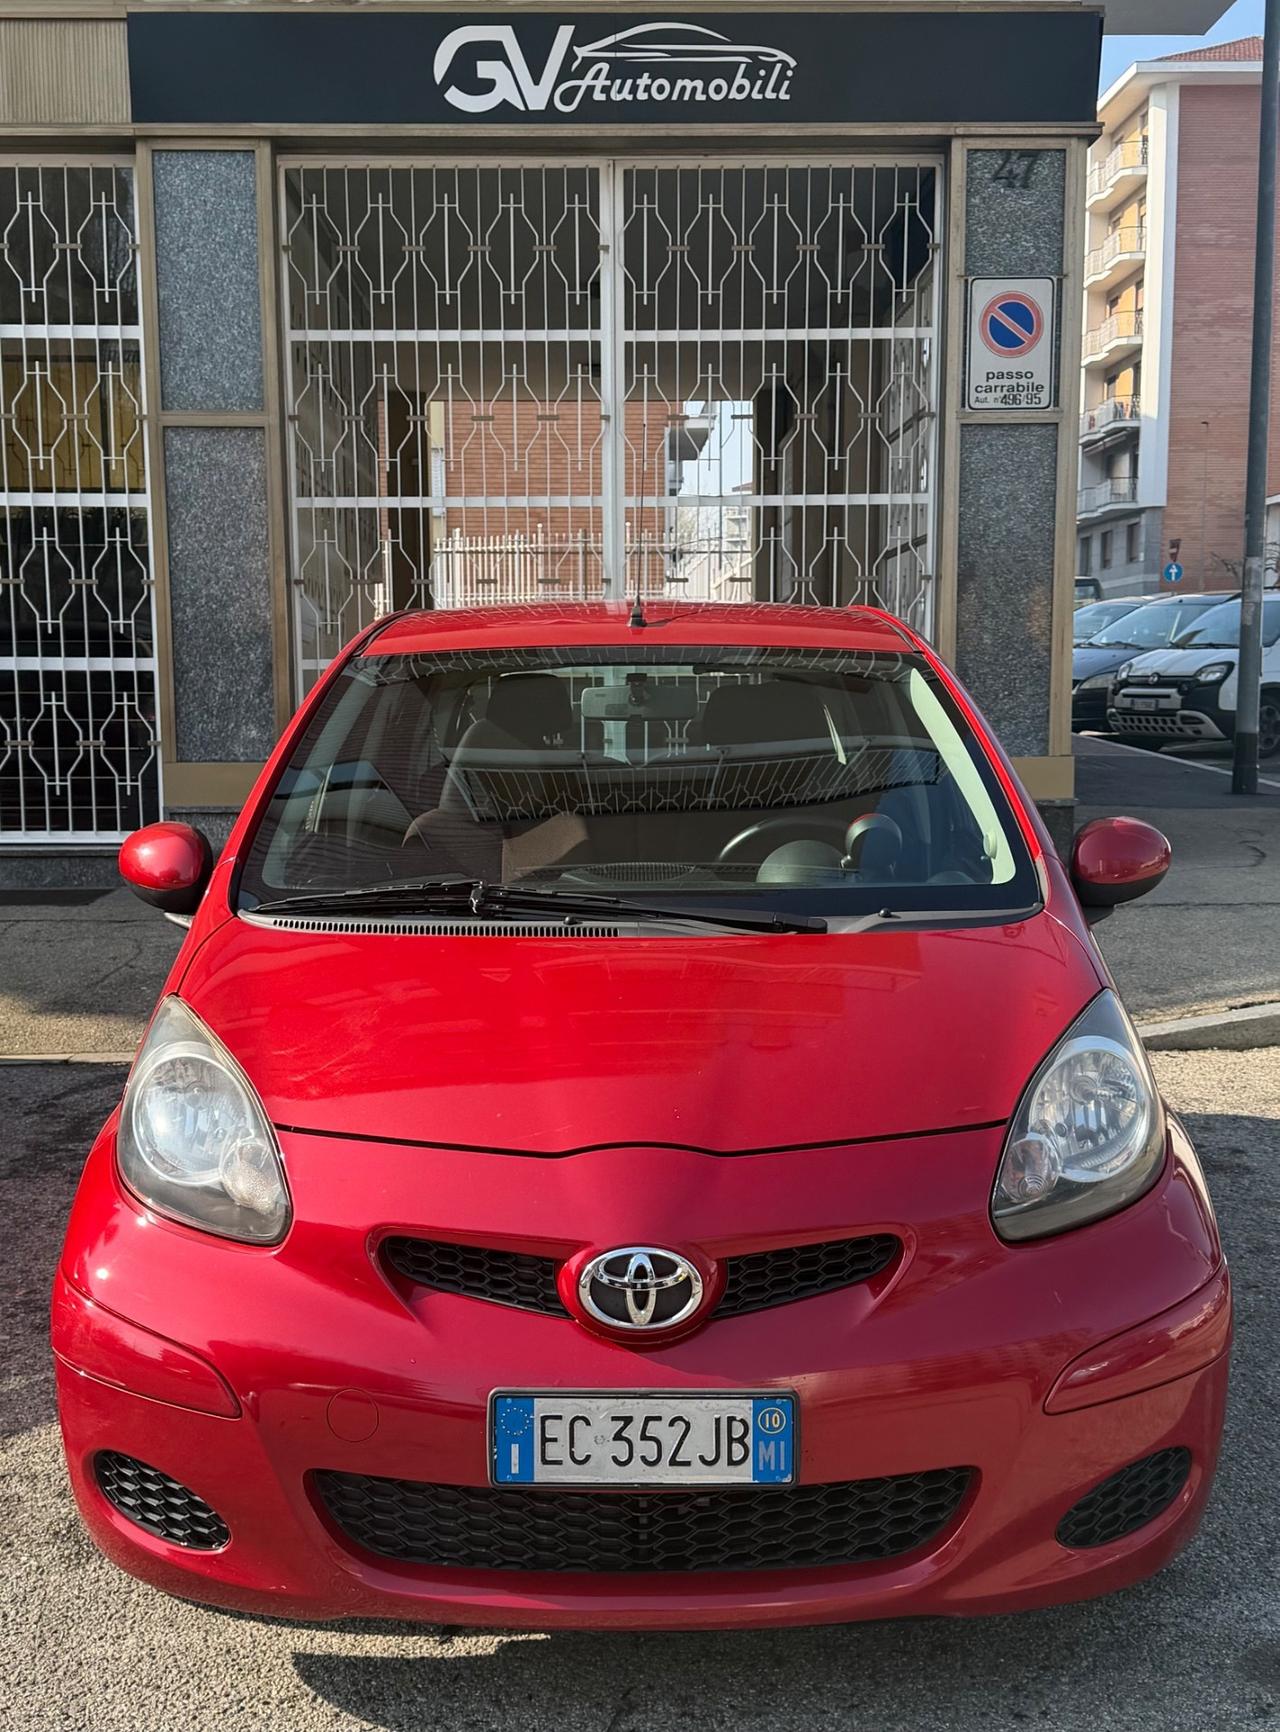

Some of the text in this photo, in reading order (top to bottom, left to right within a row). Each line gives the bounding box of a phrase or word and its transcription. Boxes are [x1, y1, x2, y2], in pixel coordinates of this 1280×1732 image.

[433, 24, 576, 113] GV
[553, 62, 794, 113] Automobili
[992, 150, 1040, 189] 47
[974, 382, 1045, 393] carrabile
[986, 370, 1034, 382] passo
[766, 1412, 781, 1428] 10
[539, 1414, 592, 1467] EC
[758, 1440, 786, 1472] MI
